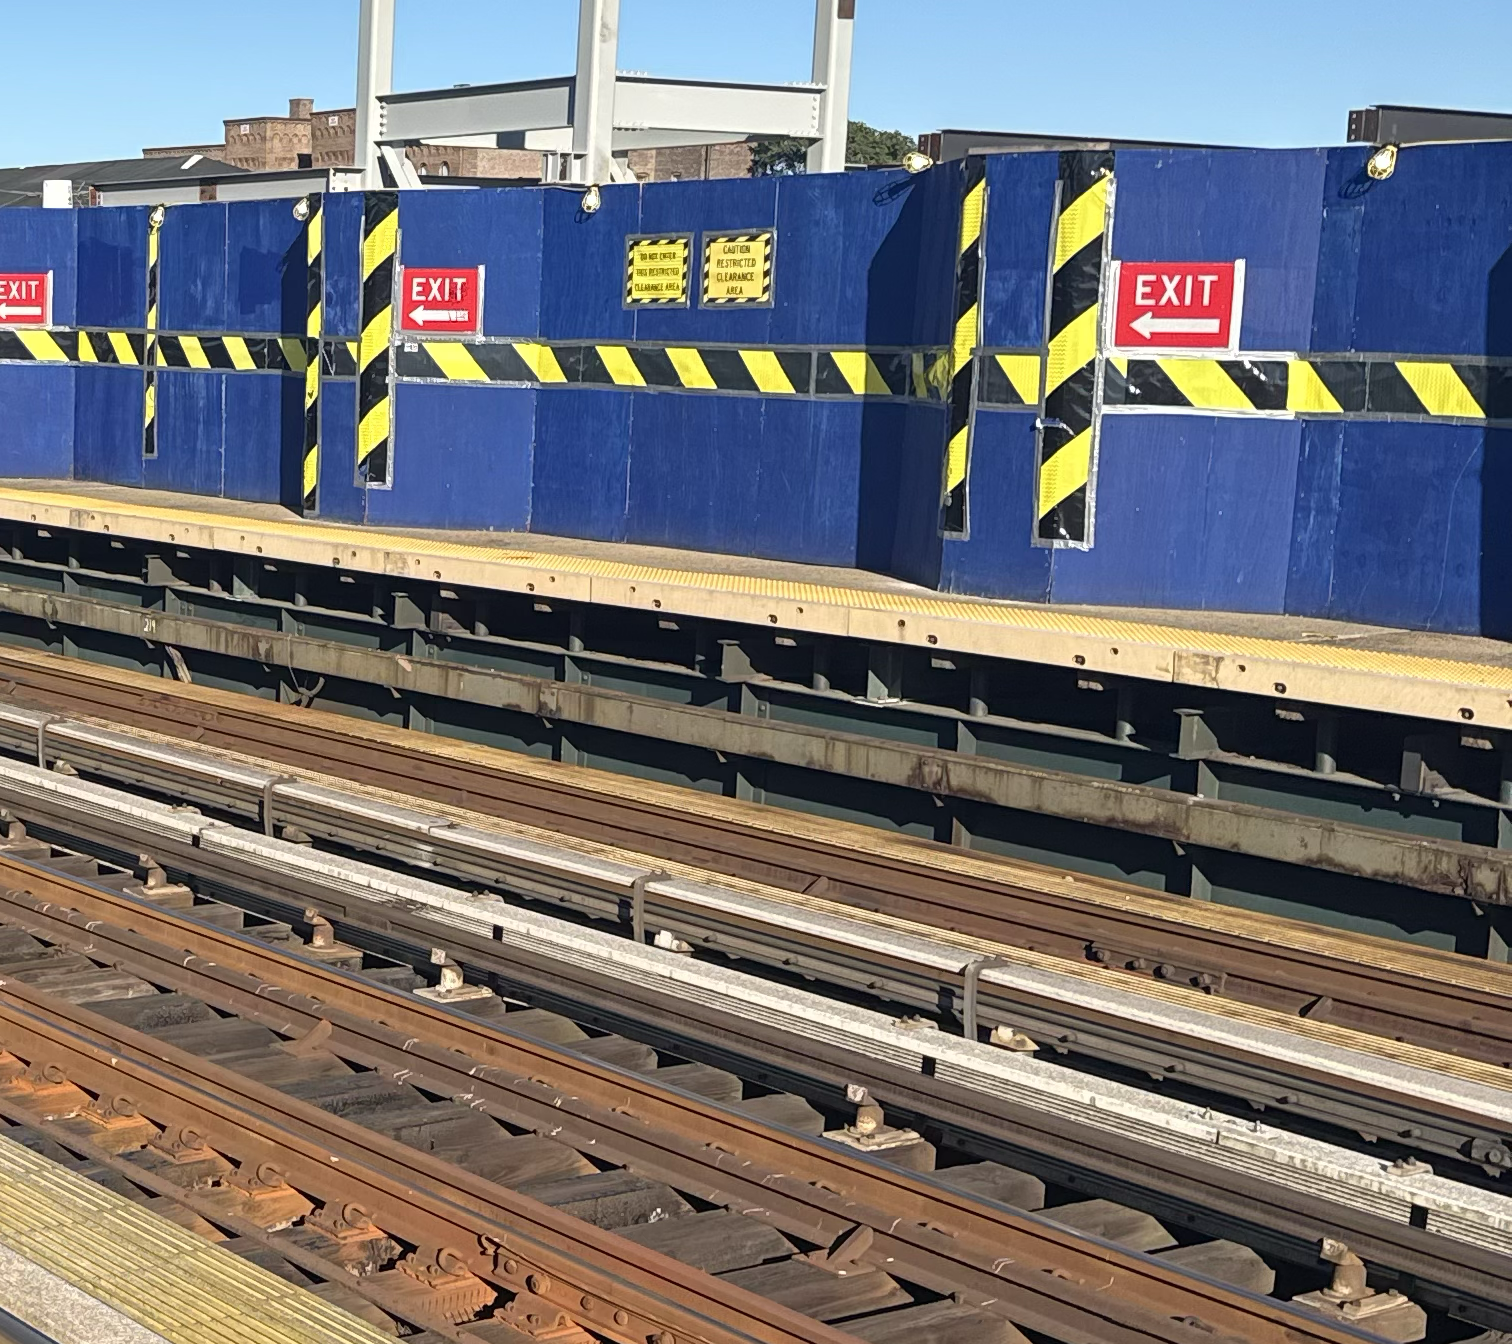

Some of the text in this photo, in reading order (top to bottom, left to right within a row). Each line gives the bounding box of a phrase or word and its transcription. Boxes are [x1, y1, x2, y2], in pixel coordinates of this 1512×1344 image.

[723, 245, 751, 254] CAUTION
[716, 258, 756, 268] RESTRICTED
[649, 267, 679, 276] RESTRICTED
[716, 272, 755, 282] CLEARANCE
[411, 277, 467, 302] EXIT
[634, 282, 680, 292] CLEARANCE AREA
[726, 286, 743, 295] AREA
[1135, 274, 1219, 307] EXIT
